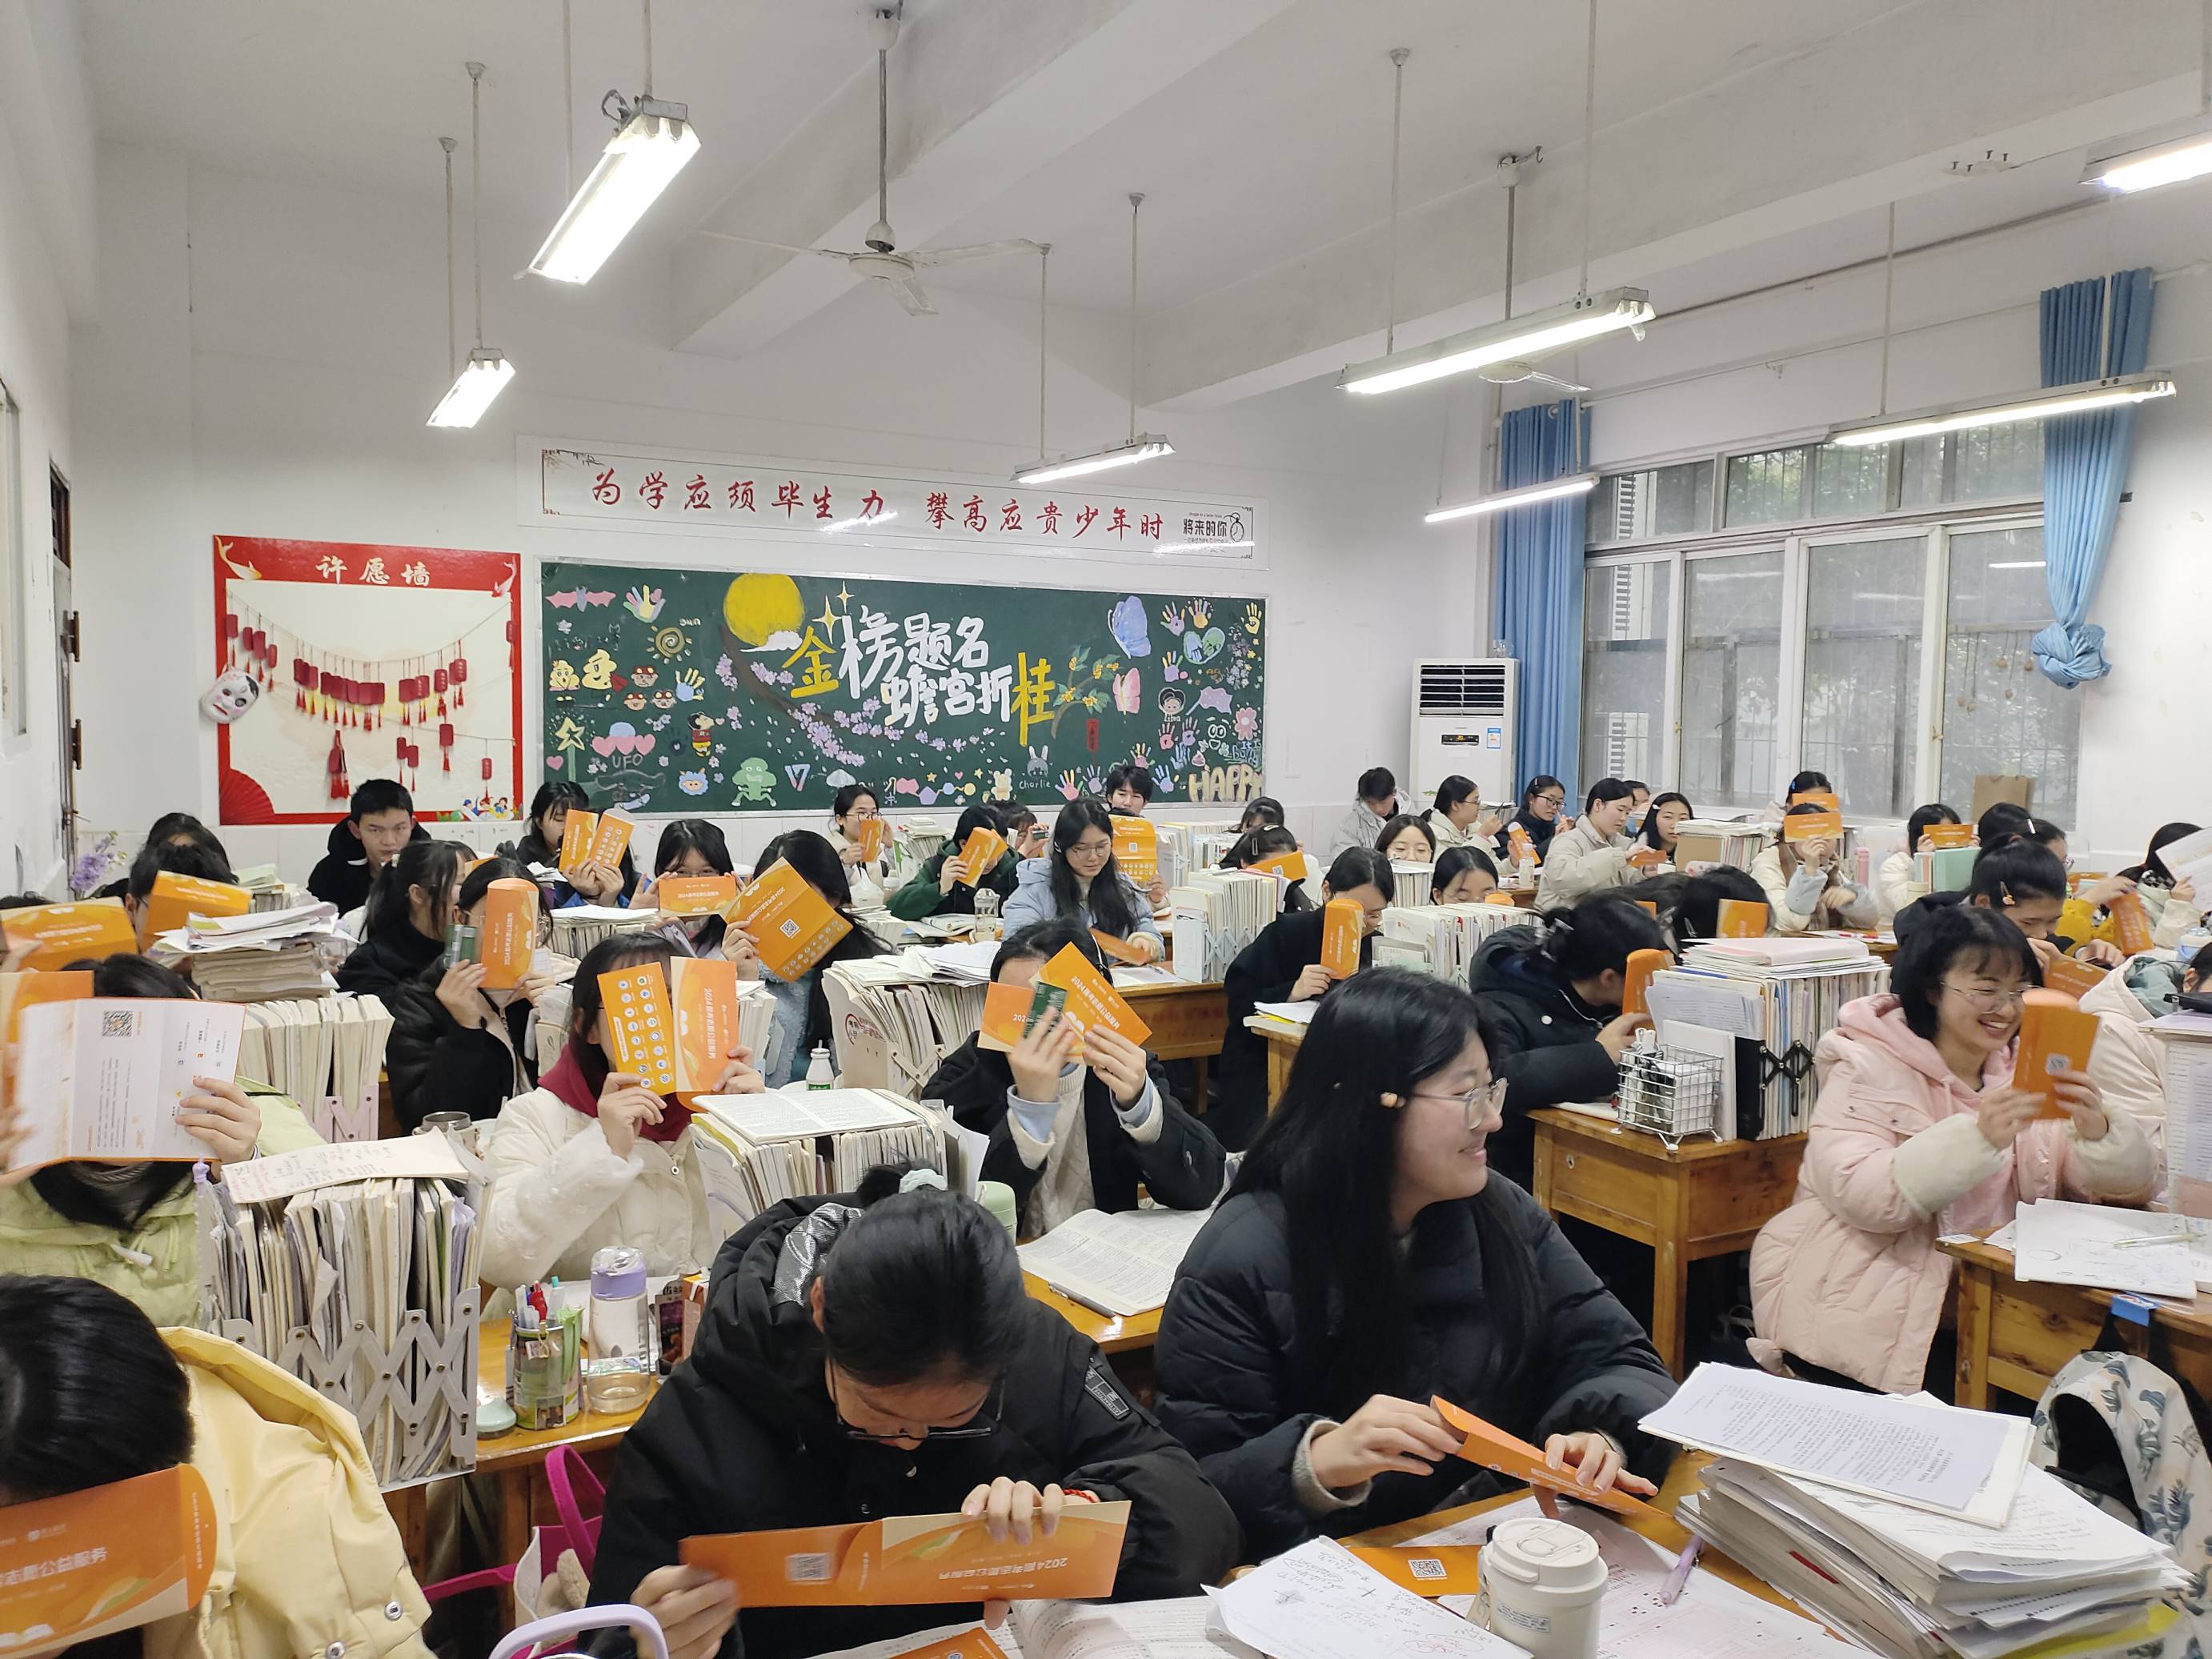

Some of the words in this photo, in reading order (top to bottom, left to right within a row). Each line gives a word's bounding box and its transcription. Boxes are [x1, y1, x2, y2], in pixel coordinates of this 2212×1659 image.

[925, 491, 1164, 542] 攀高应贵少年时
[1183, 518, 1227, 537] 将来的你
[315, 555, 431, 587] 许愿墙
[782, 604, 990, 699] 金榜题名
[880, 651, 1058, 747] 蟾宫折桂
[611, 754, 643, 770] UFO
